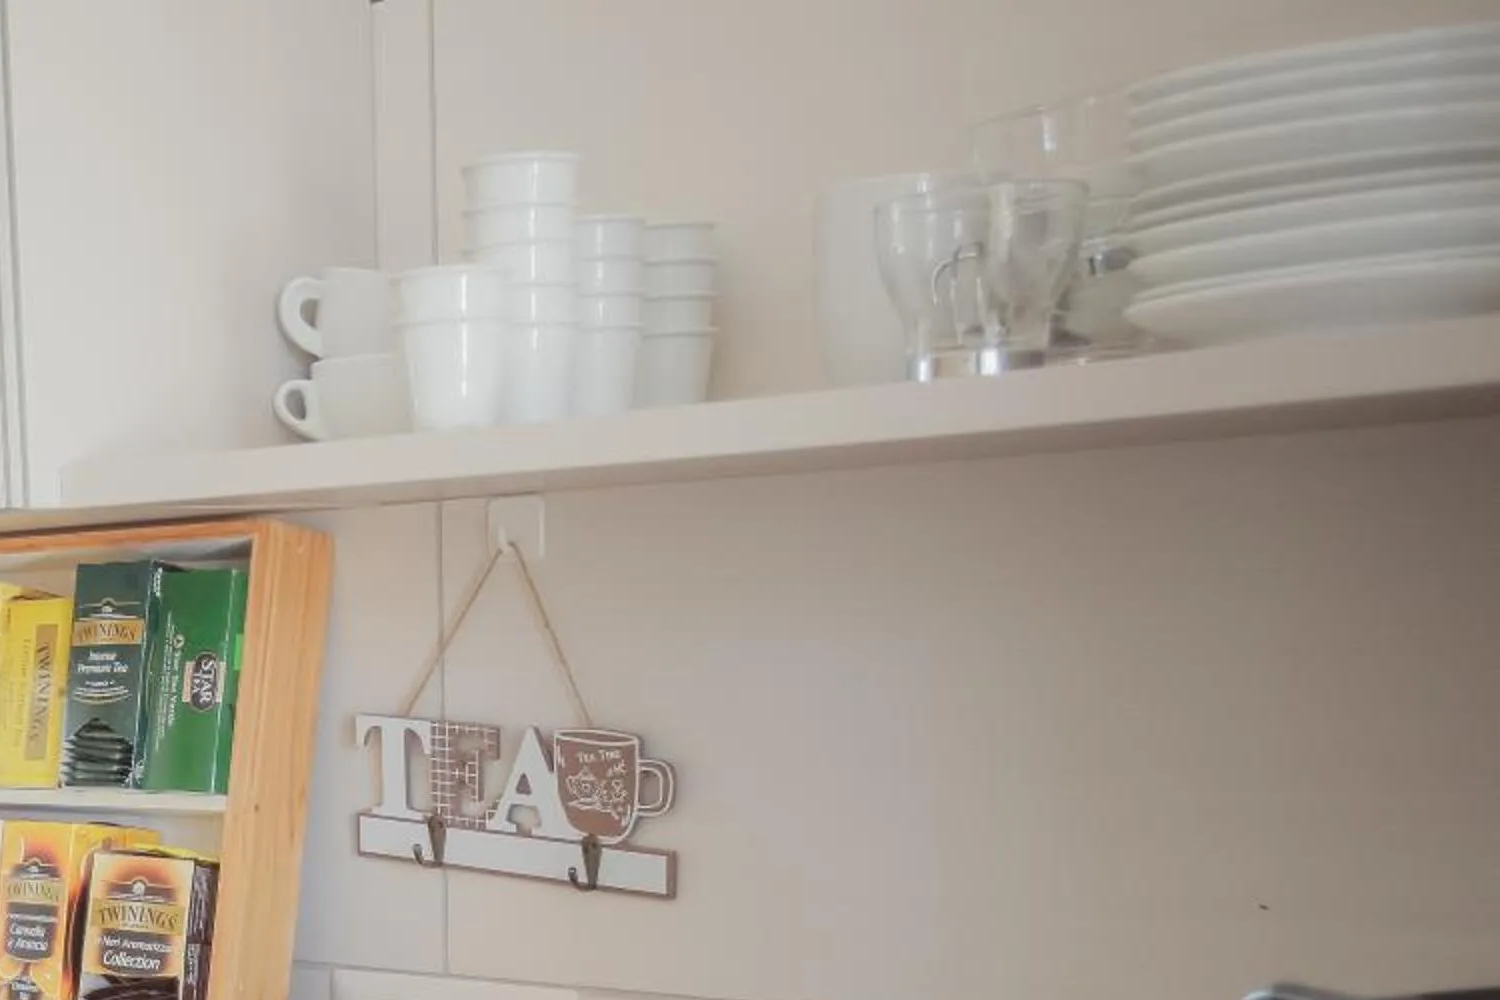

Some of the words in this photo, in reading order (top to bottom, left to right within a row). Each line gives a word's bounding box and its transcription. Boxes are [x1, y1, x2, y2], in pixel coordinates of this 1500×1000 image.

[28, 642, 54, 742] TWININGS
[191, 671, 202, 693] TEA
[198, 659, 216, 704] STAR
[356, 713, 582, 841] TEA
[99, 904, 180, 929] TWININGS
[103, 950, 161, 970] Collection
